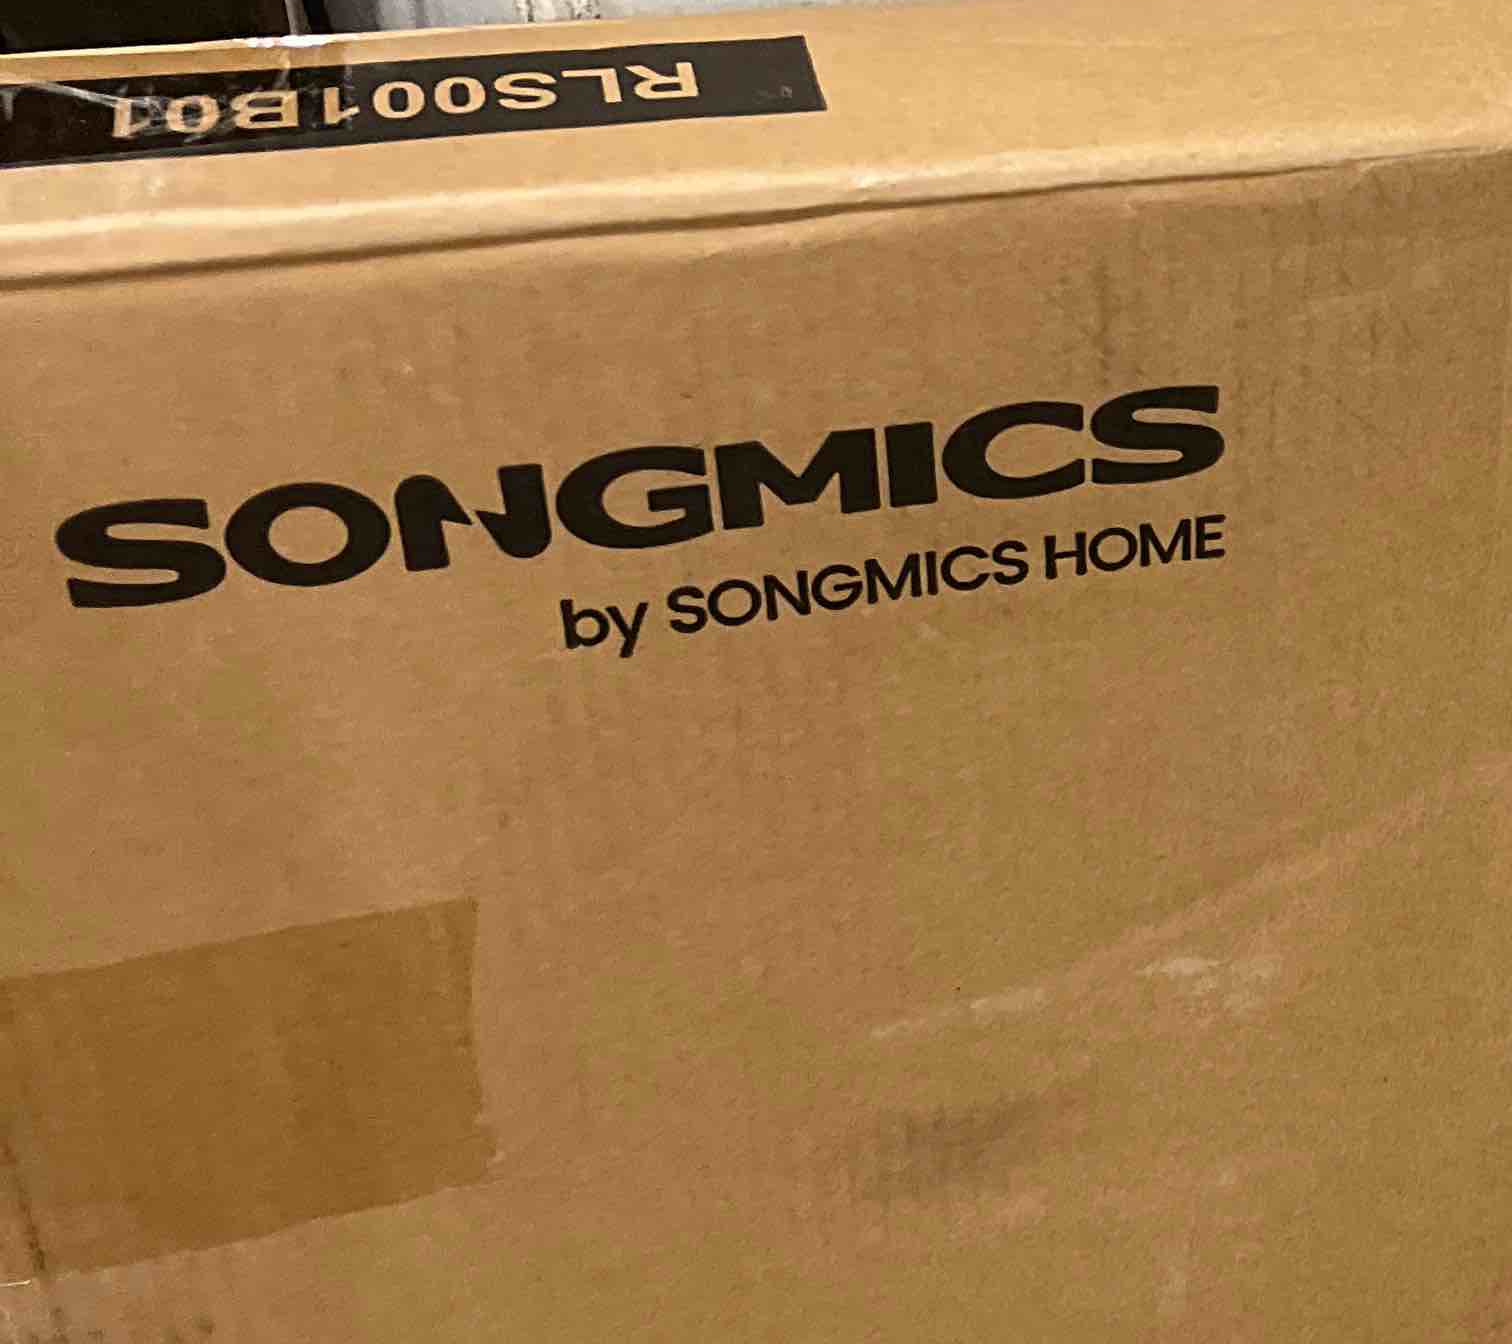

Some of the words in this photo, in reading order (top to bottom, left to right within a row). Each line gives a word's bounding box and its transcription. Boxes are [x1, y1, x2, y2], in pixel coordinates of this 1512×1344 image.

[110, 61, 700, 139] RLS001B01
[54, 385, 1226, 609] SONGMICS
[560, 598, 649, 659] by
[666, 539, 1030, 634] SONGMICS
[1043, 513, 1227, 580] HOME
